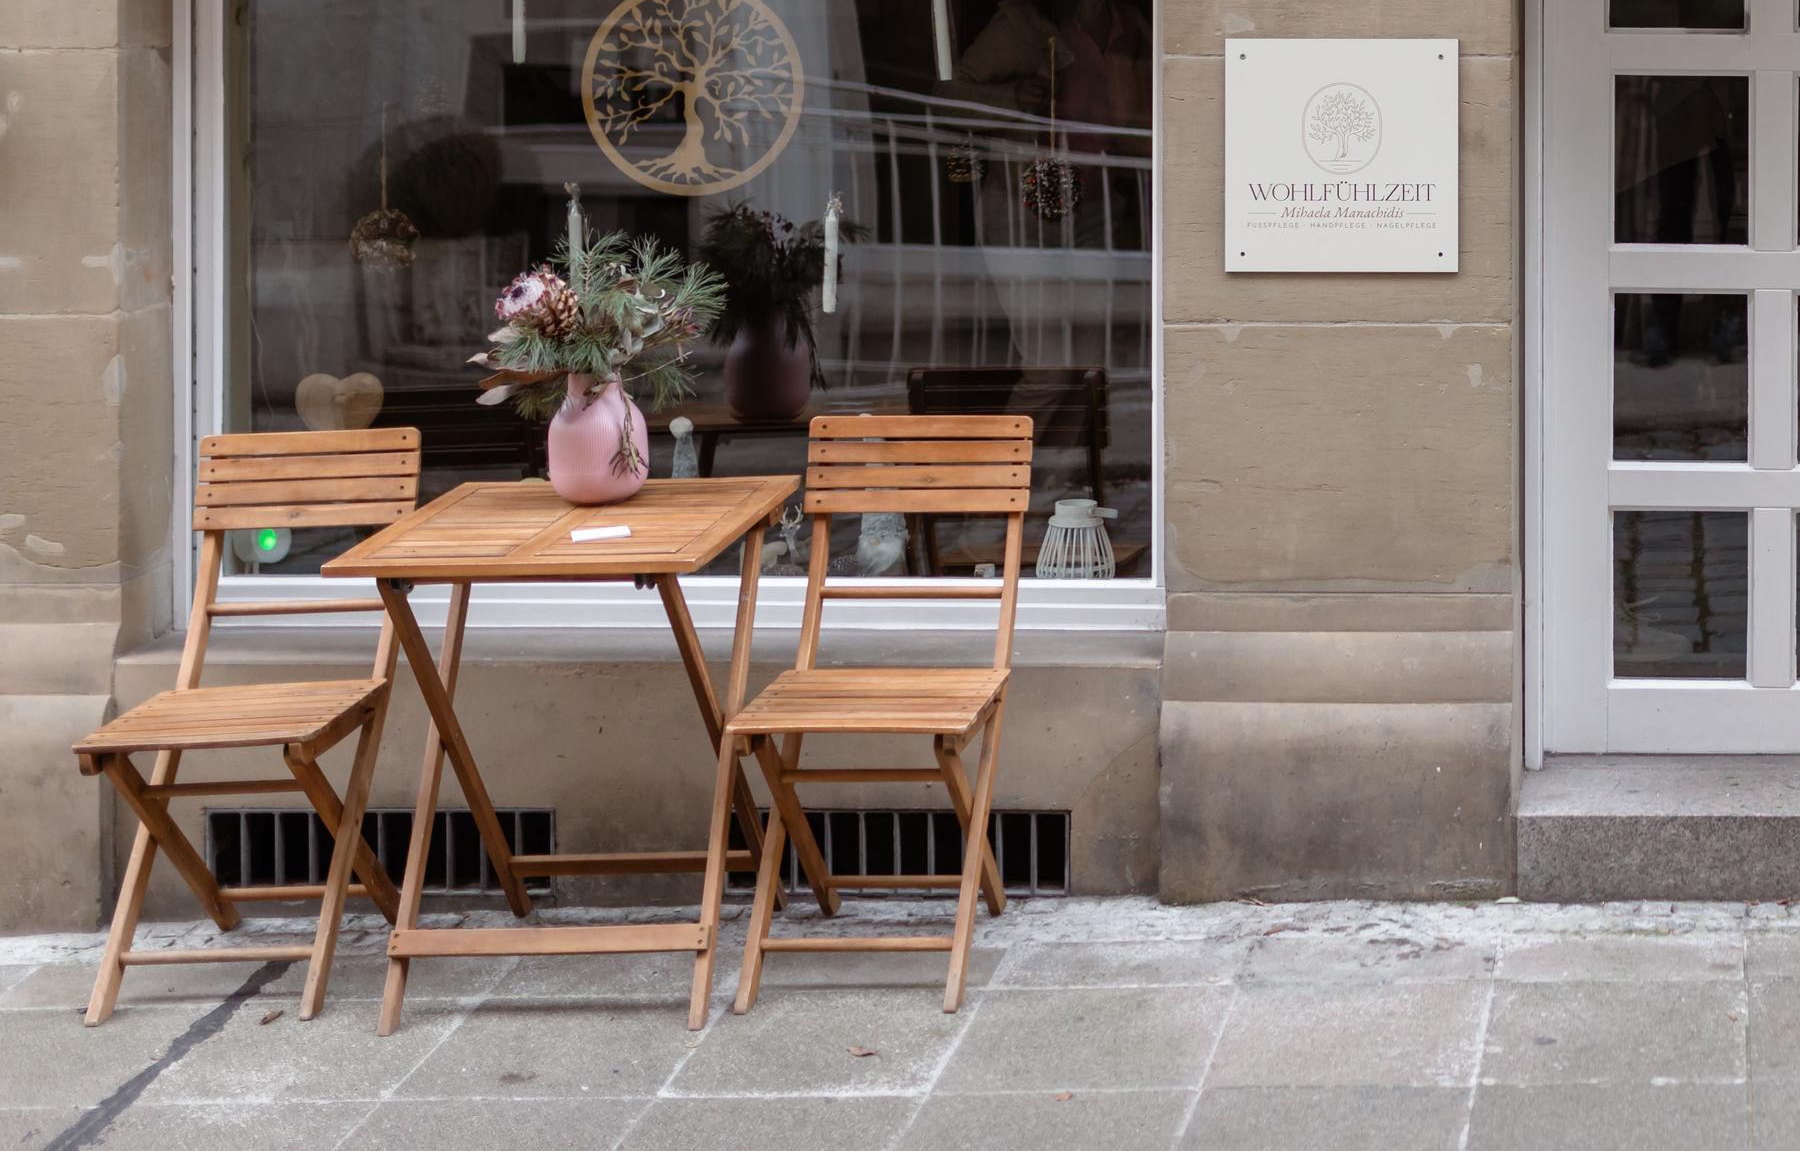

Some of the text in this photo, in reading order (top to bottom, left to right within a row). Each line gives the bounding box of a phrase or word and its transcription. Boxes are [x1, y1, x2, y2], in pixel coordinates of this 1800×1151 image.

[1248, 181, 1437, 202] WOHLFÜHLZEIT
[1281, 206, 1404, 219] Mihaela Manachidis
